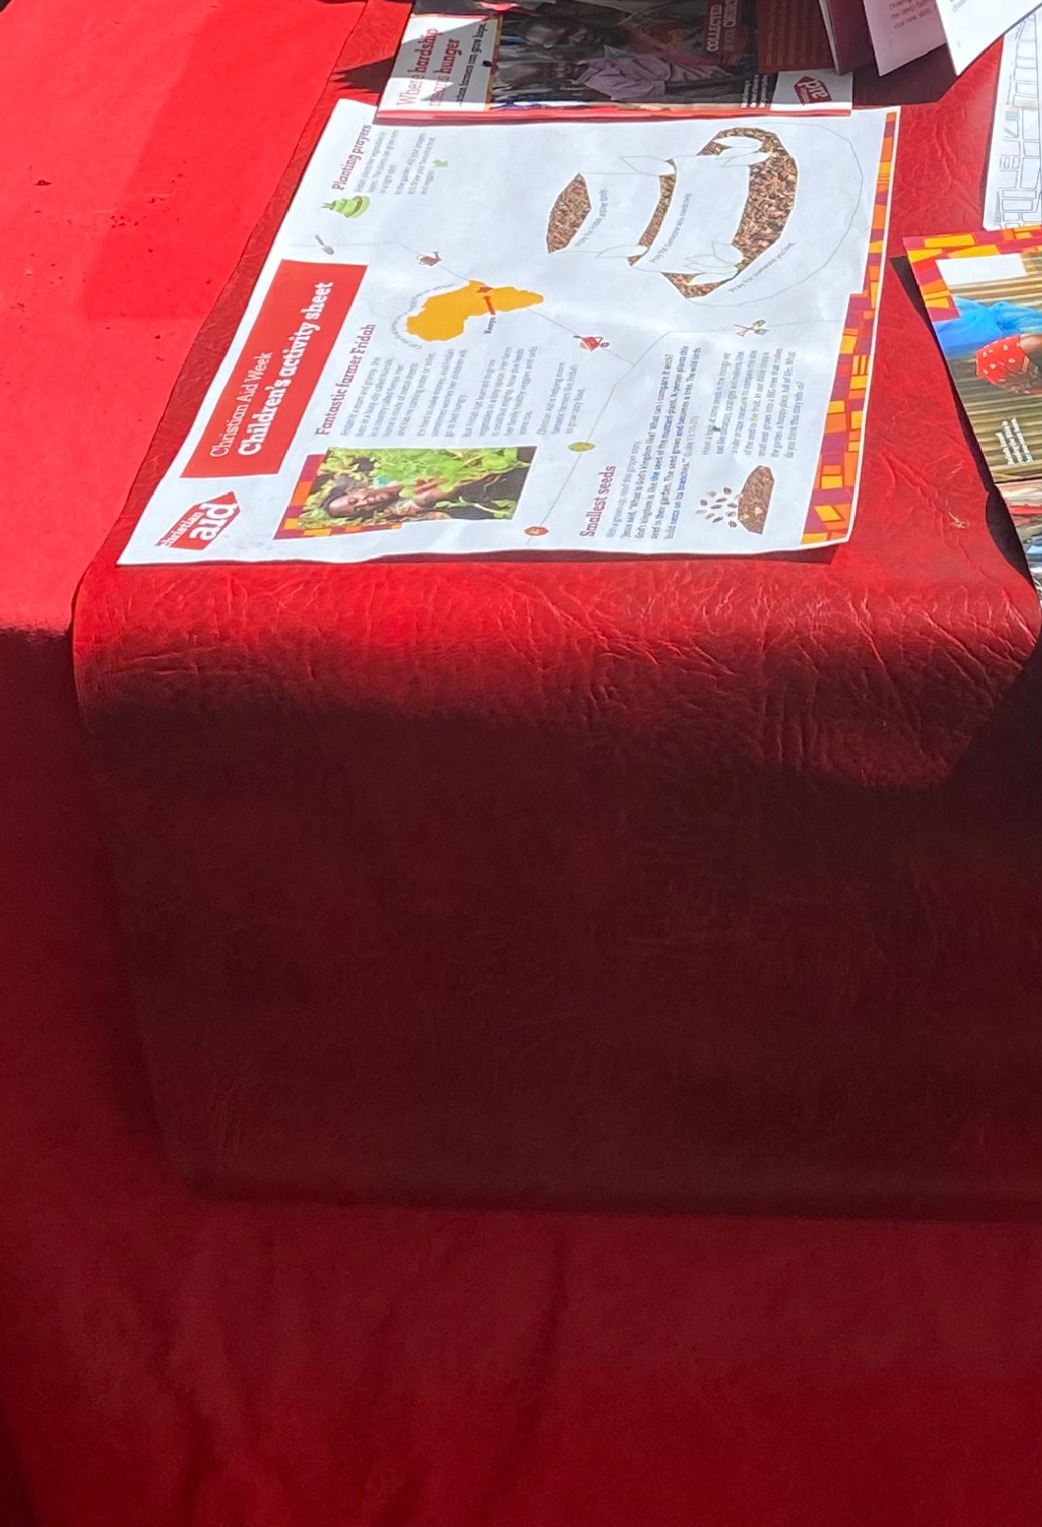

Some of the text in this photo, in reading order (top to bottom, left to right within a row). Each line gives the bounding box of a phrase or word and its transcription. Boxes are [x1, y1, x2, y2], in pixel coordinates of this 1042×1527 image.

[432, 37, 461, 73] hunger
[706, 4, 722, 51] COLLECTED
[396, 28, 442, 105] Where hardship
[796, 80, 828, 97] aid
[329, 124, 372, 190] Planting prayers
[235, 281, 335, 455] Children's activity sheet
[313, 323, 377, 435] Fantastic farmer Fridah
[208, 351, 274, 456] Christian Aid Week
[156, 510, 204, 547] christian
[191, 502, 239, 540] aid
[578, 465, 616, 536] Smallest seeds
